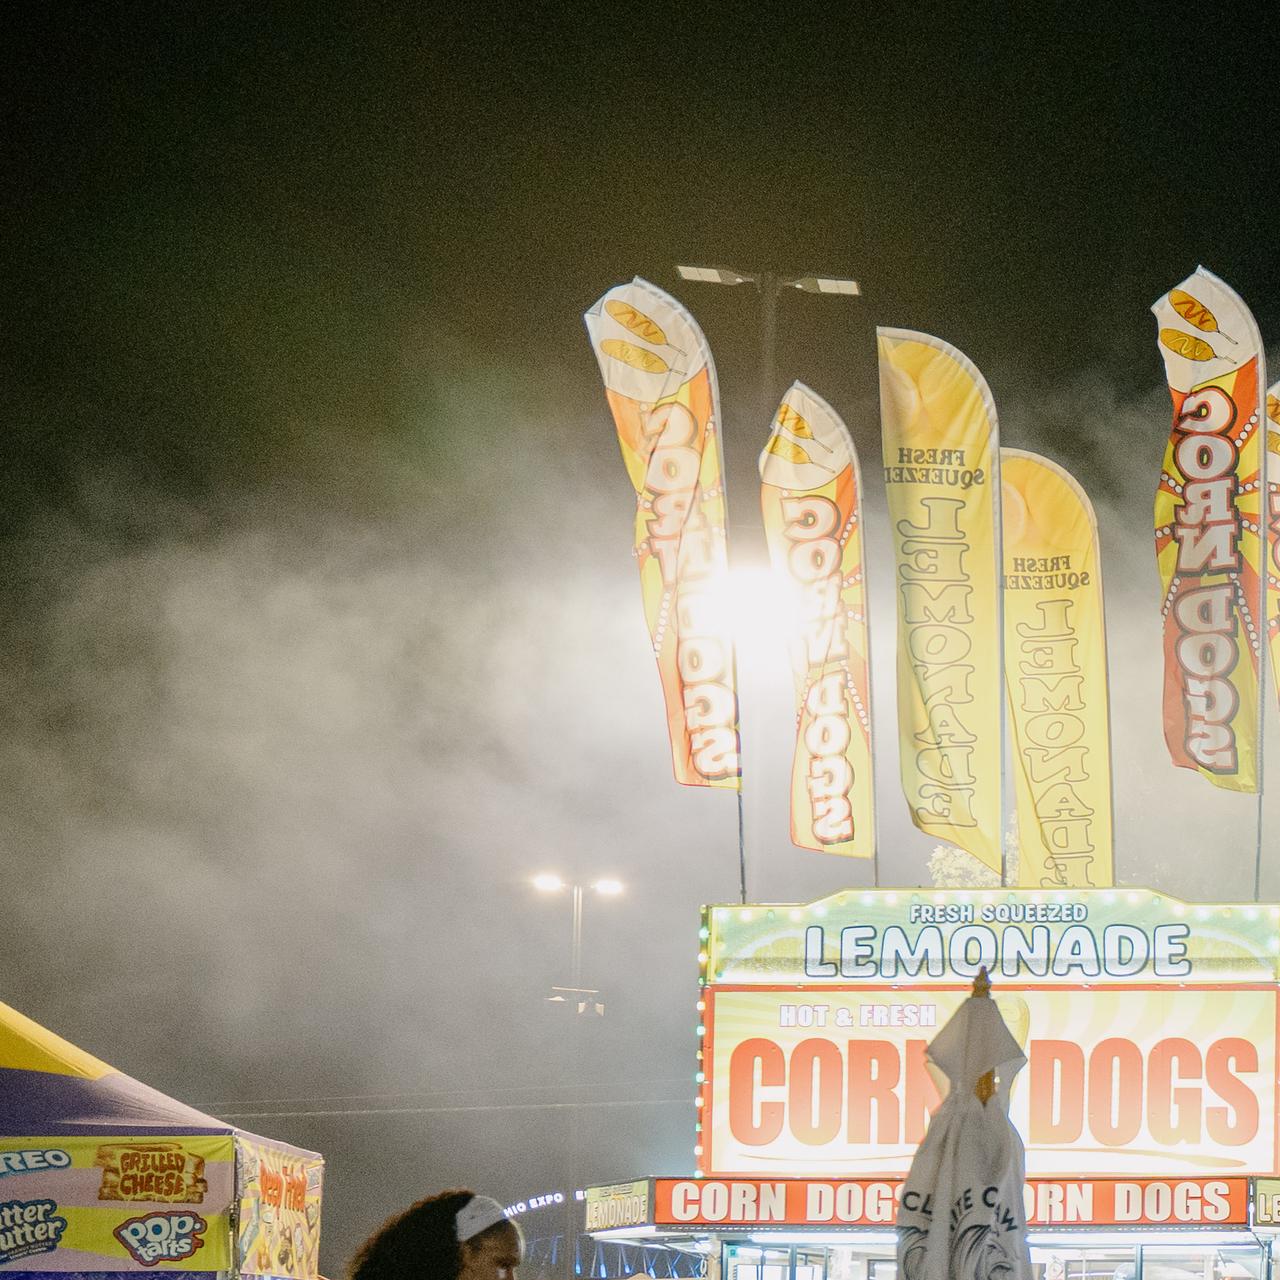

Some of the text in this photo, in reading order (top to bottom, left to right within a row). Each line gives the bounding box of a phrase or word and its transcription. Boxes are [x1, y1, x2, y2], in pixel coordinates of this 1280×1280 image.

[909, 903, 1088, 923] FRESH SQUEEZED
[804, 923, 1192, 979] LEMONADE
[779, 1004, 937, 1028] HOT & FRESH
[1029, 1037, 1261, 1148] DOGS
[0, 1150, 69, 1174] REO
[120, 1151, 186, 1173] GRILLED
[119, 1173, 186, 1196] CHEESE
[503, 1201, 527, 1218] HIO
[528, 1192, 564, 1210] EXPO
[671, 1181, 900, 1223] CORN DOG
[901, 1190, 934, 1216] CL
[1026, 1181, 1231, 1223] RN DOGS
[0, 1204, 51, 1229] tter
[0, 1221, 62, 1250] utter
